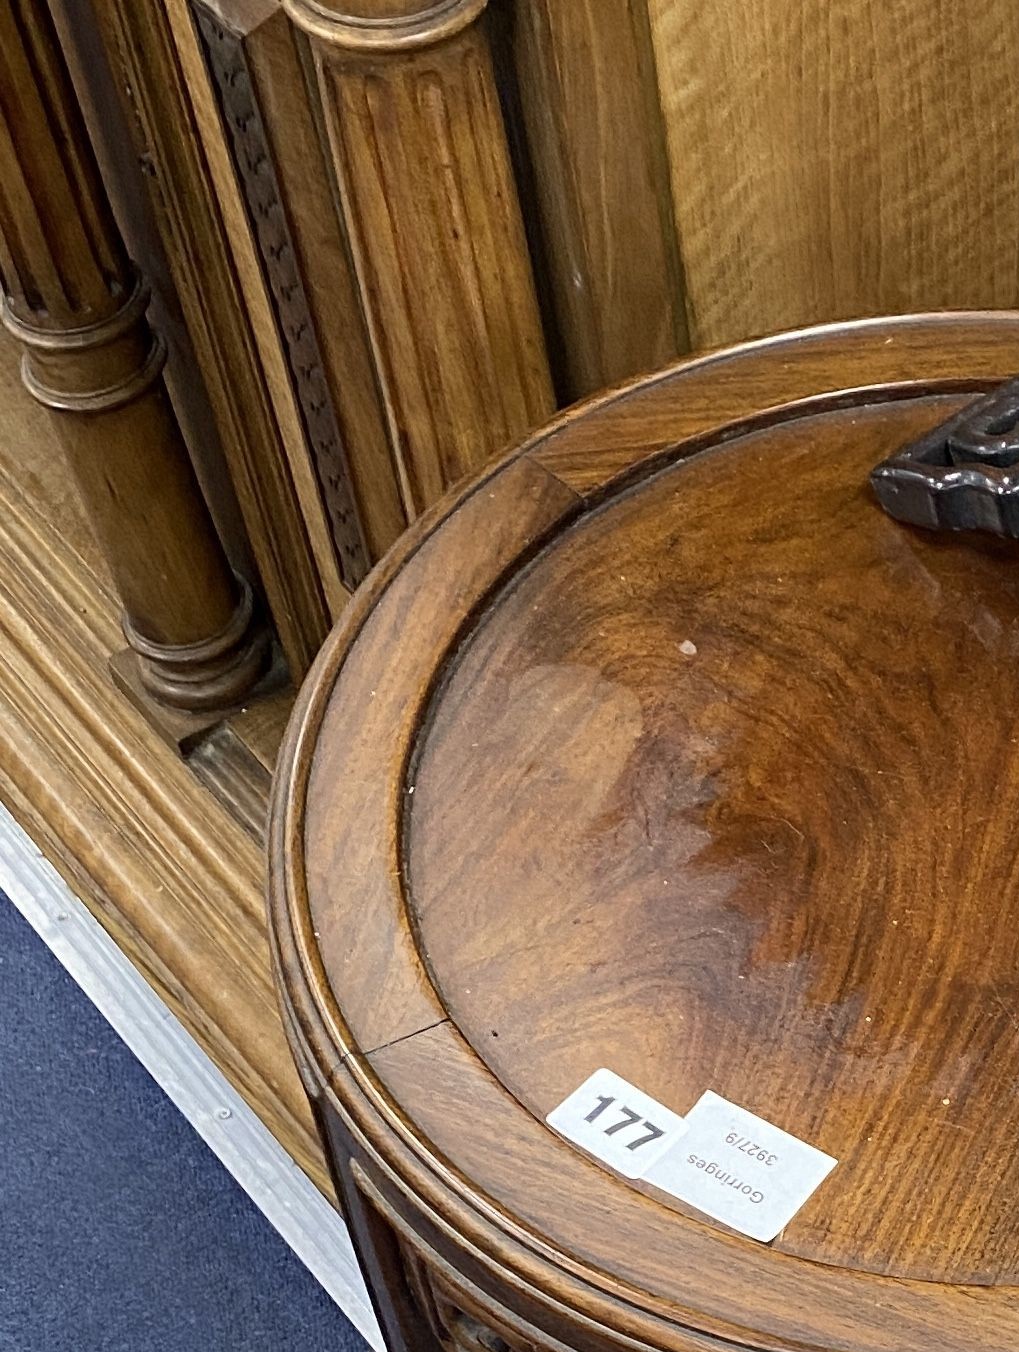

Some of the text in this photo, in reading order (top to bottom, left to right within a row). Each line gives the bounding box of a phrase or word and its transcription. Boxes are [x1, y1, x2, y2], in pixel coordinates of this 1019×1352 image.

[583, 1095, 666, 1151] 177
[725, 1131, 778, 1166] 3927/9
[686, 1153, 765, 1204] Gorringes
